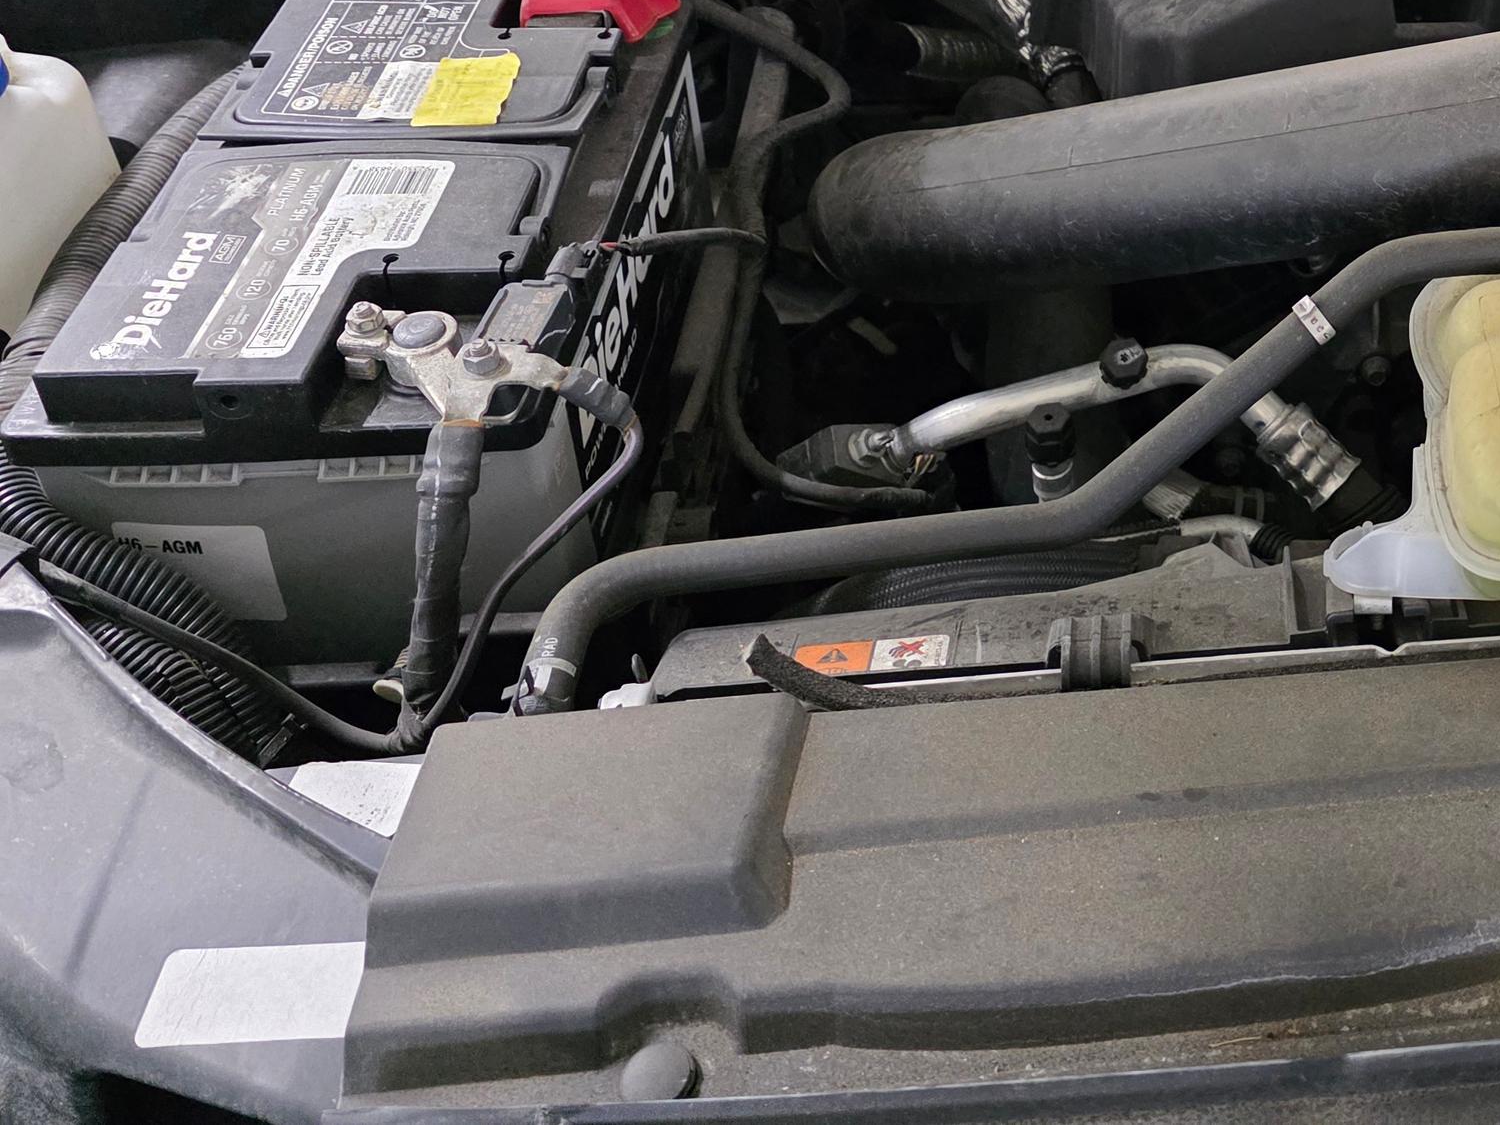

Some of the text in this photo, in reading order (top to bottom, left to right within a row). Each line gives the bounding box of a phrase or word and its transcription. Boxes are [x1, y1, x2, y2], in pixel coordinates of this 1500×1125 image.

[282, 17, 338, 89] DANGER/POISON
[266, 167, 307, 215] PLATINUM
[290, 183, 324, 220] H6-AGM
[211, 235, 237, 261] AGM
[269, 239, 290, 251] 70
[296, 217, 340, 275] NON-SPILLABLE
[310, 217, 354, 275] Lead Acid Battery
[113, 231, 220, 345] DieHard
[243, 279, 268, 296] 120
[212, 327, 238, 346] 760
[541, 635, 558, 659] RAD
